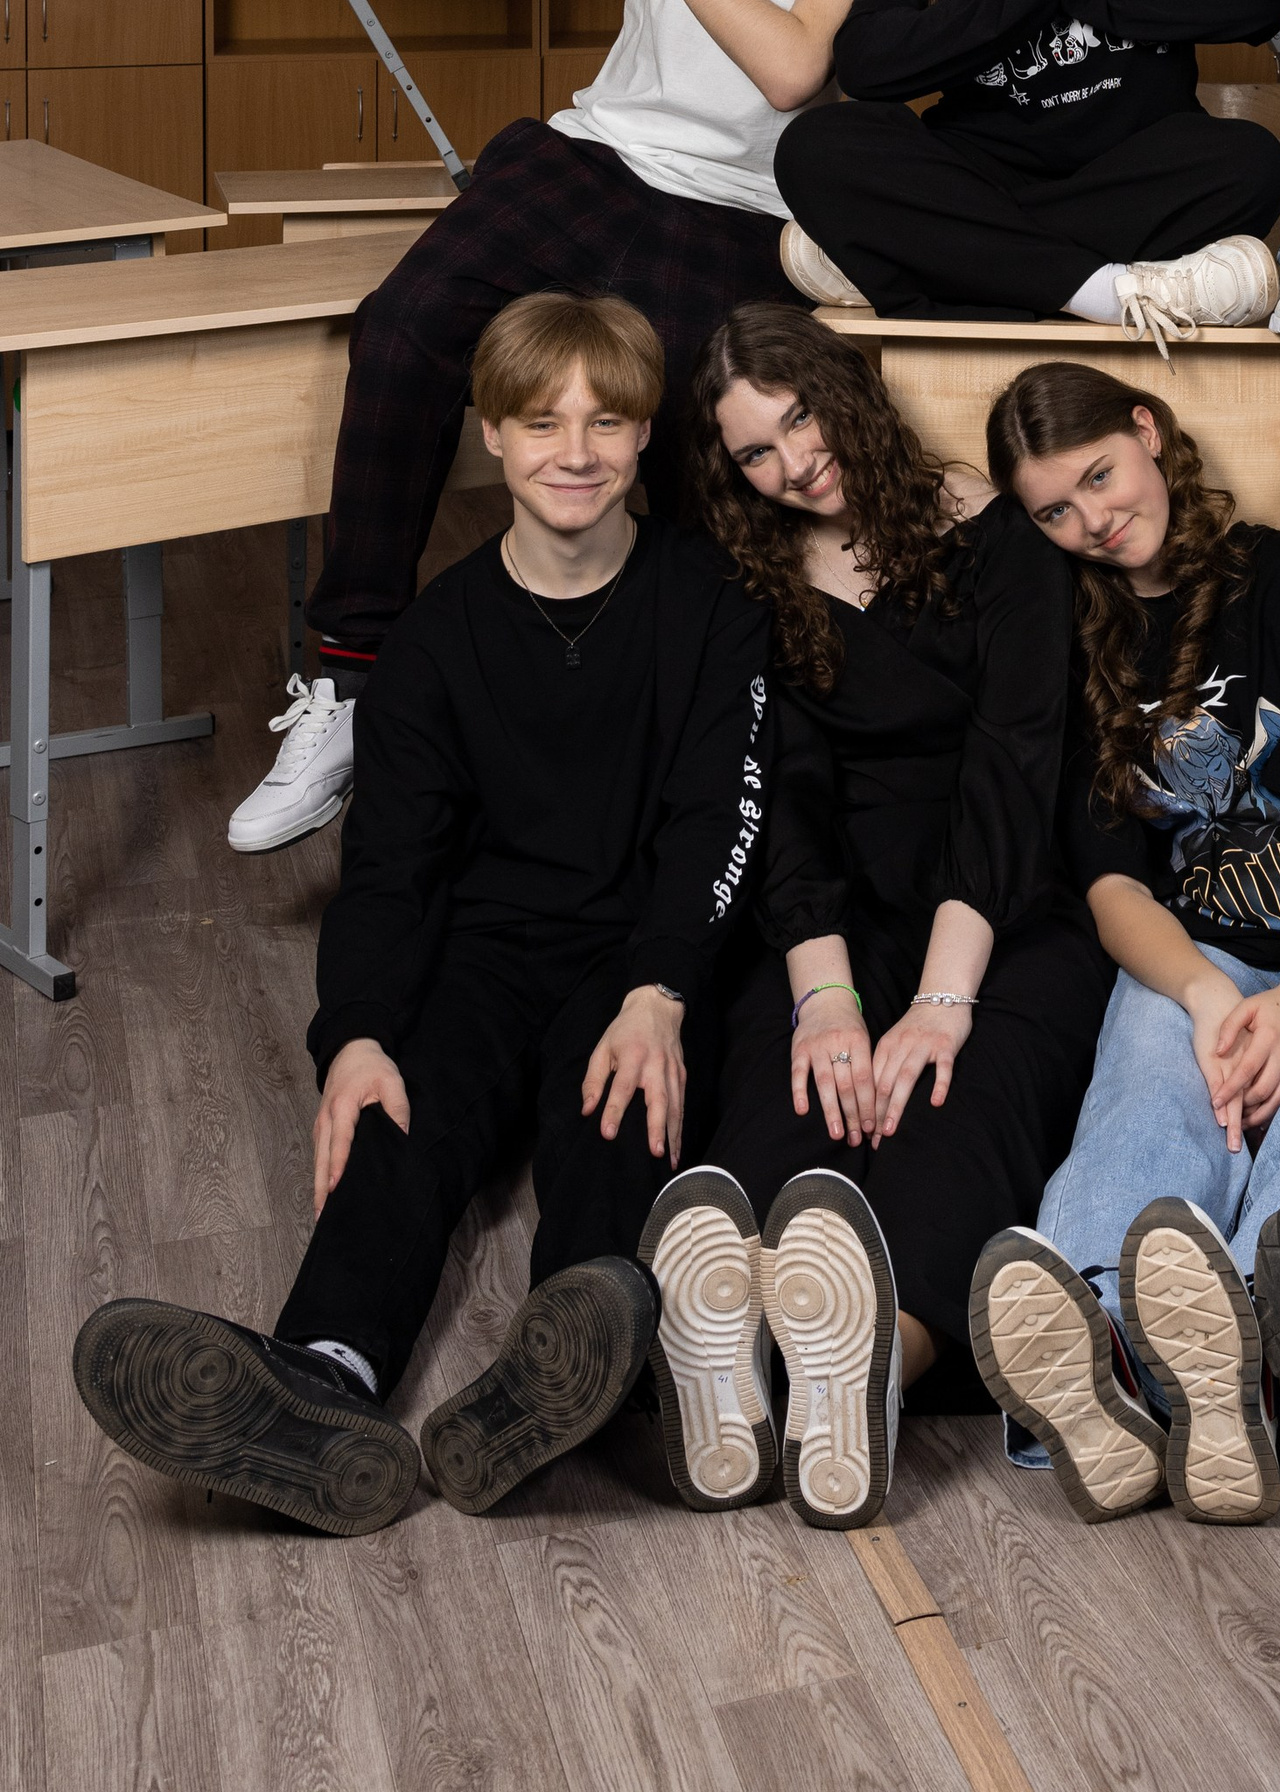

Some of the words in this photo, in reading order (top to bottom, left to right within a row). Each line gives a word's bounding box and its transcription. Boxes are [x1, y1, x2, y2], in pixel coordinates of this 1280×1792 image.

[1041, 95, 1059, 108] DON'T
[1082, 87, 1089, 99] BE
[1102, 78, 1122, 89] SHARK
[718, 1374, 729, 1383] 41
[816, 1385, 826, 1394] 41
